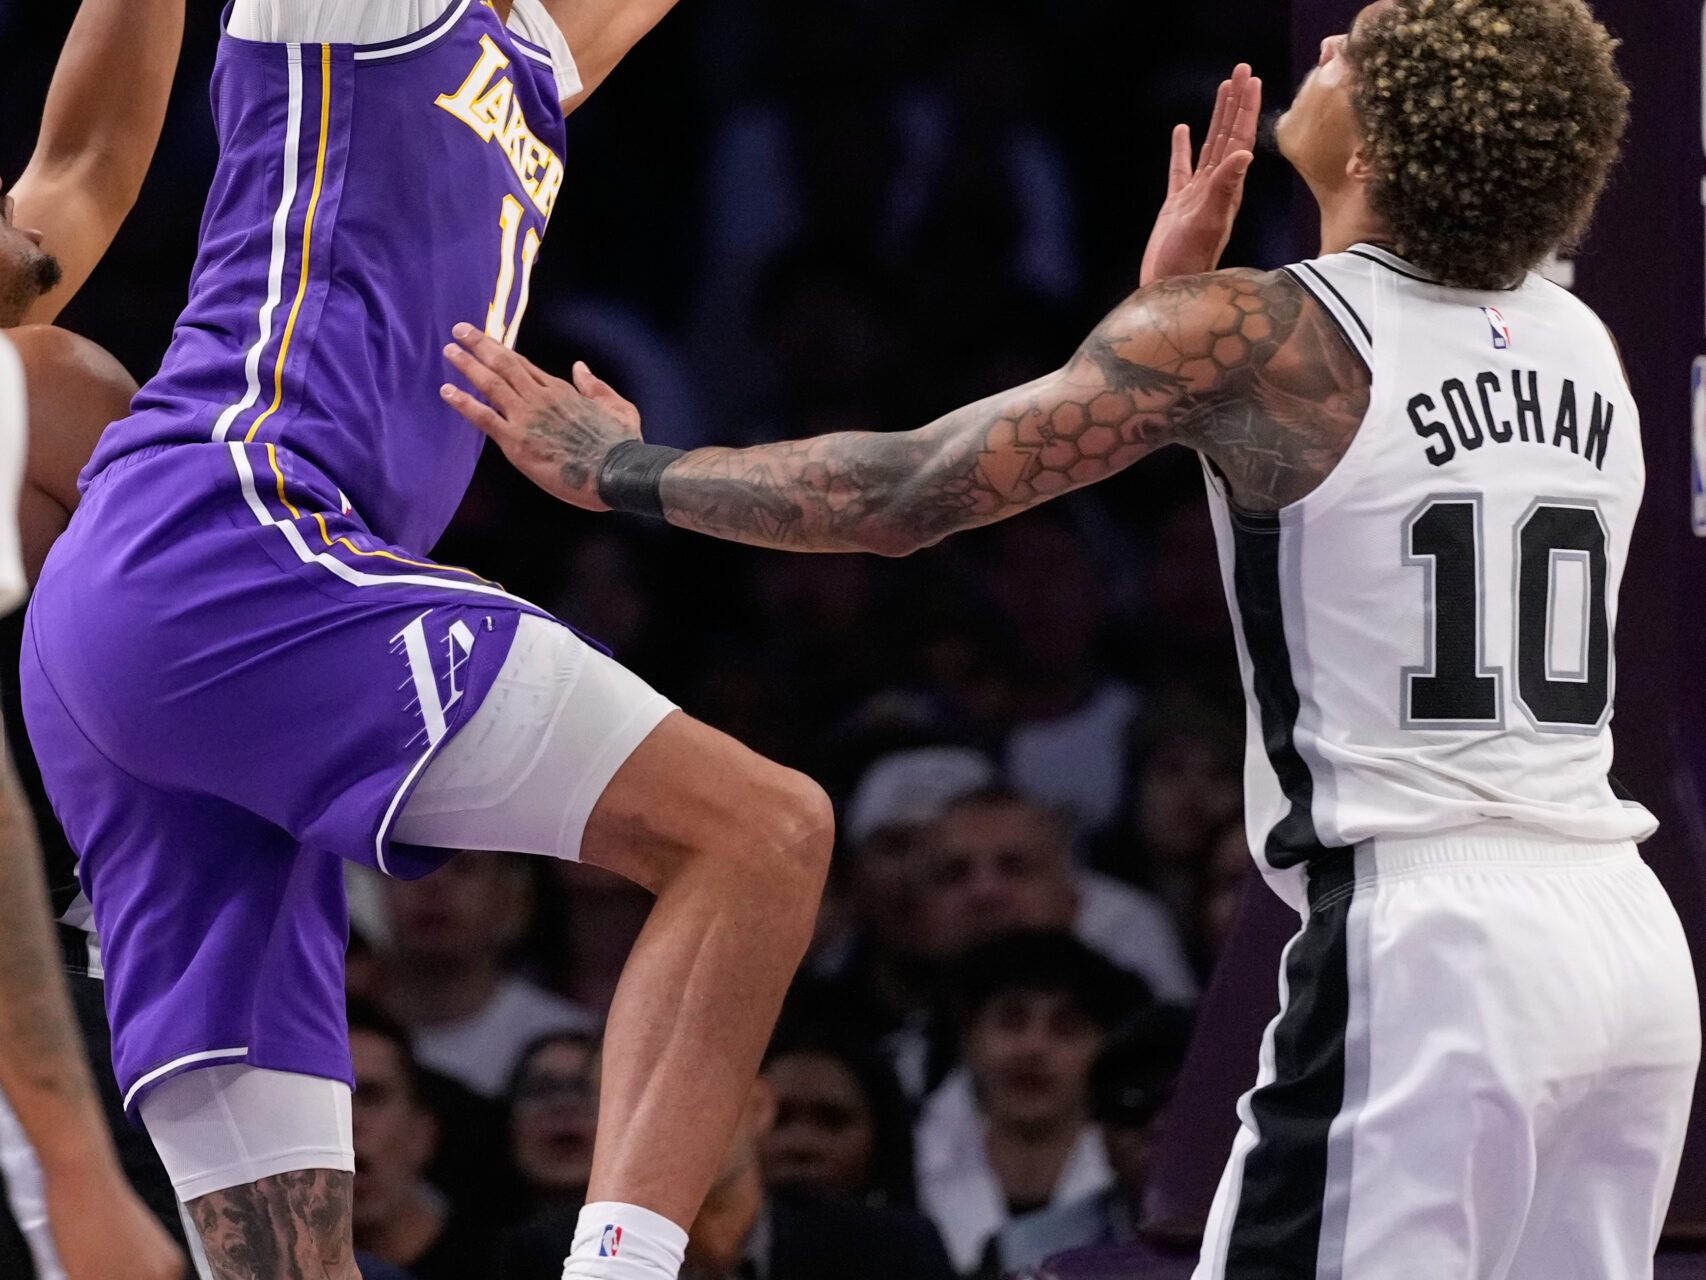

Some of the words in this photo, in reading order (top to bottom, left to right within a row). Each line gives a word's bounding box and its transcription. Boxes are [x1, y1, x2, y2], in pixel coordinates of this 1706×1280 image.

[434, 33, 564, 239] LAKER
[1406, 369, 1614, 471] SOCHAN
[1400, 492, 1615, 736] 10
